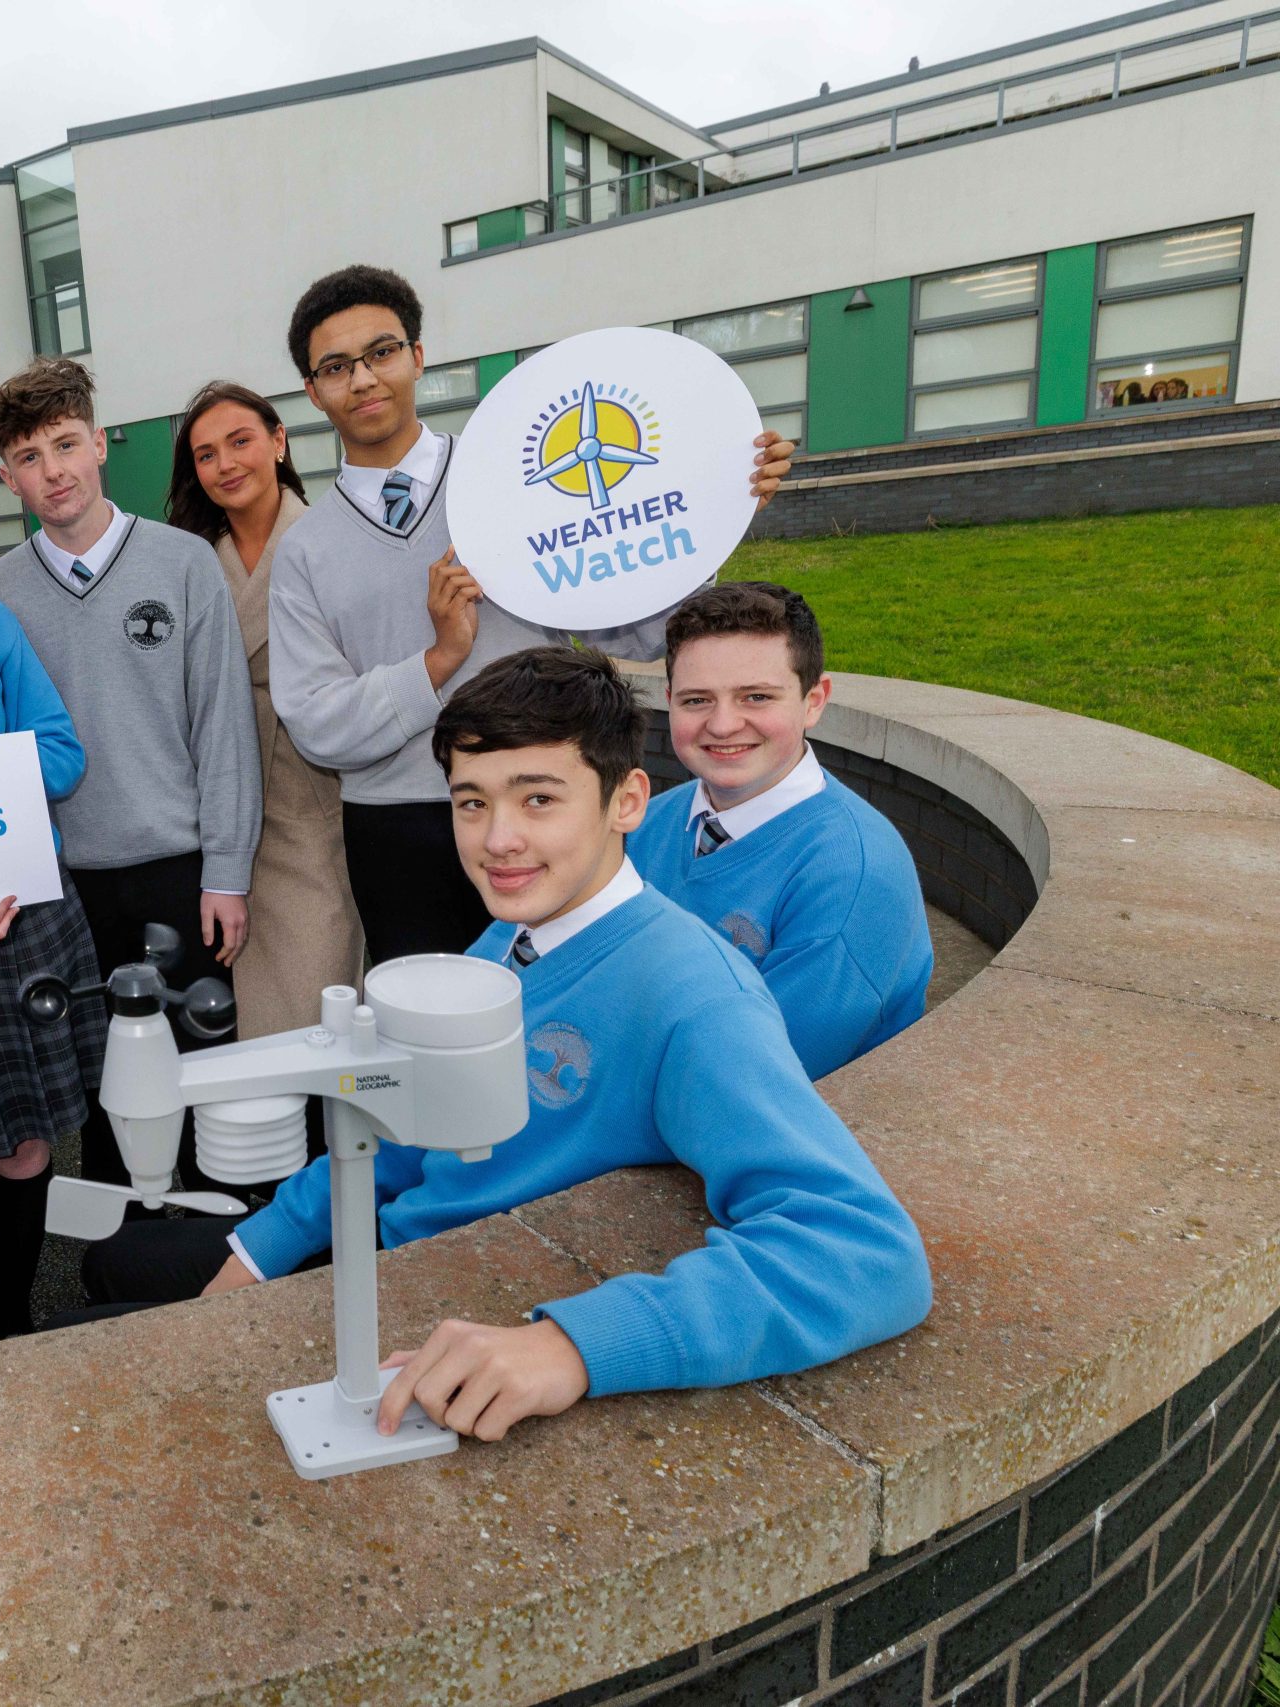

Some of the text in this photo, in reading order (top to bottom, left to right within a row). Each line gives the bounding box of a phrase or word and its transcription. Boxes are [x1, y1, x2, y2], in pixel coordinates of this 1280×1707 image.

[527, 490, 688, 556] WEATHER
[532, 522, 697, 593] Watch
[356, 1074, 391, 1083] NATIONAL
[356, 1080, 401, 1091] GEOGRAPHIC
